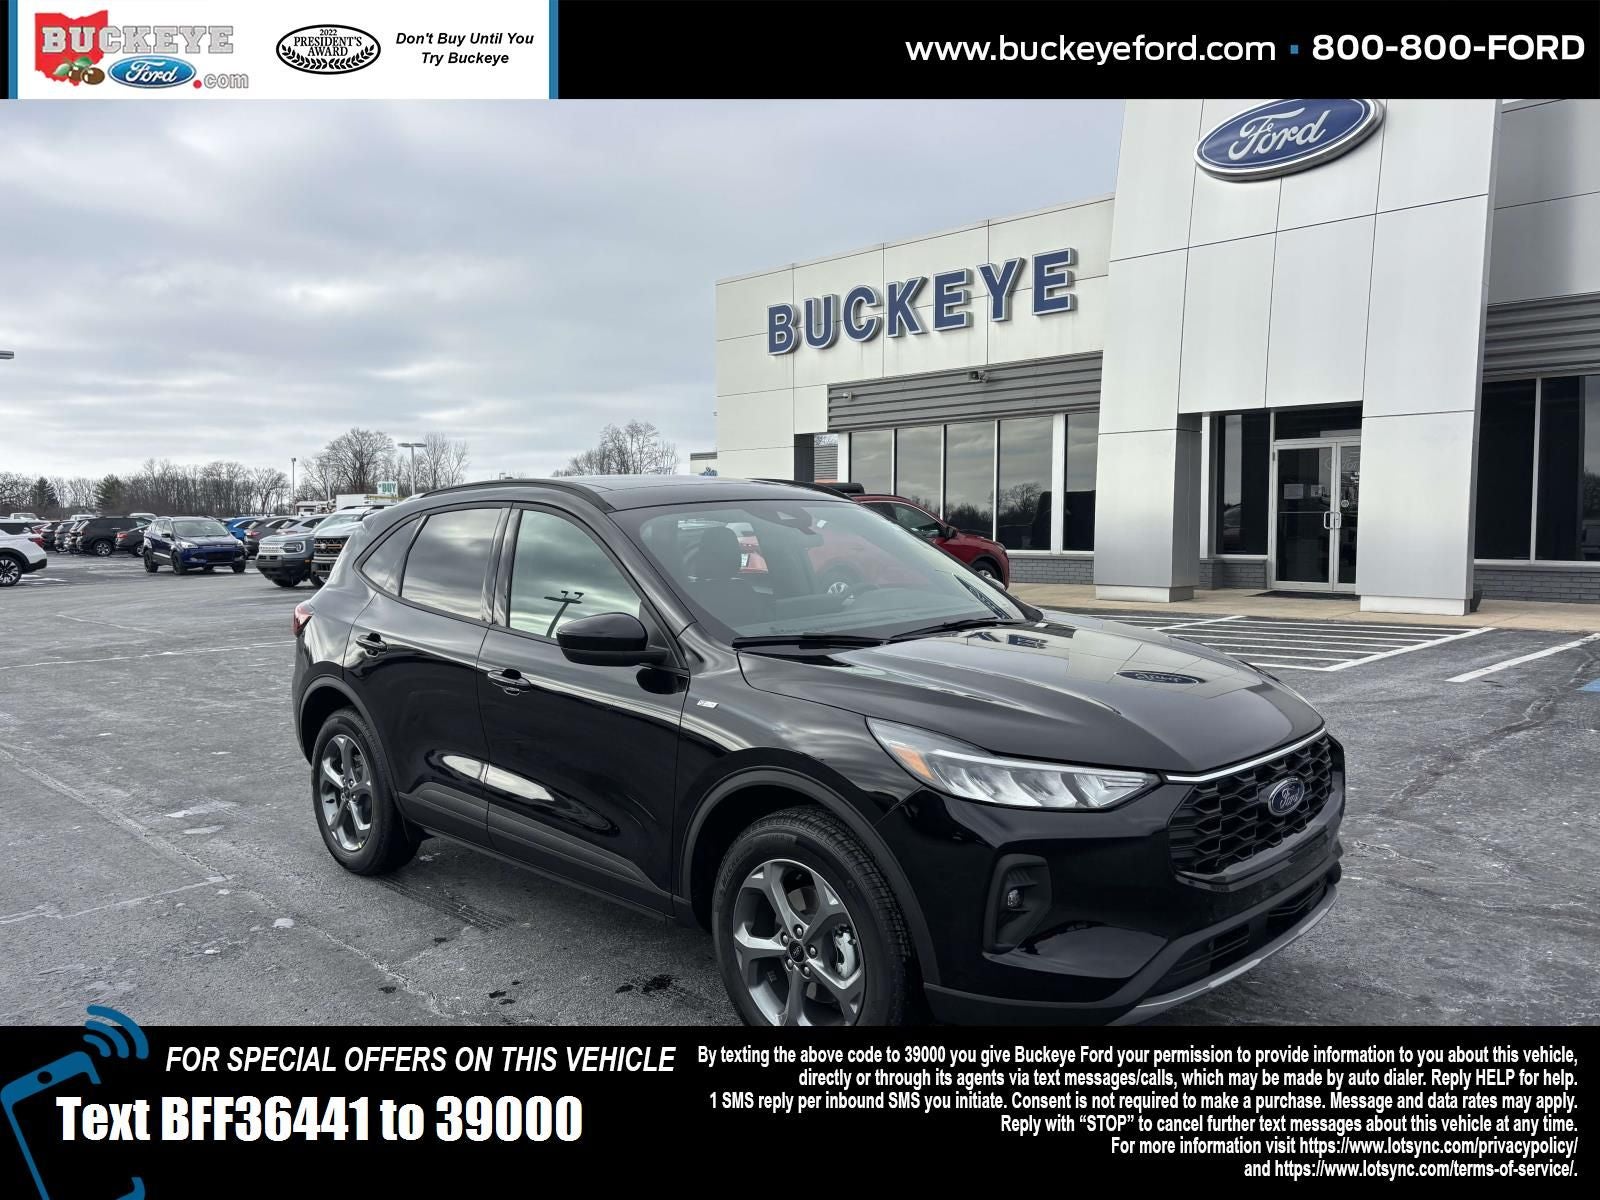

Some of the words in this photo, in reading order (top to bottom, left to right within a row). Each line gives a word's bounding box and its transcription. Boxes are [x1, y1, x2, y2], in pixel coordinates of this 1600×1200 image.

[1228, 107, 1332, 161] Ford
[766, 247, 1078, 356] BUCKEYE
[382, 483, 396, 493] BUY
